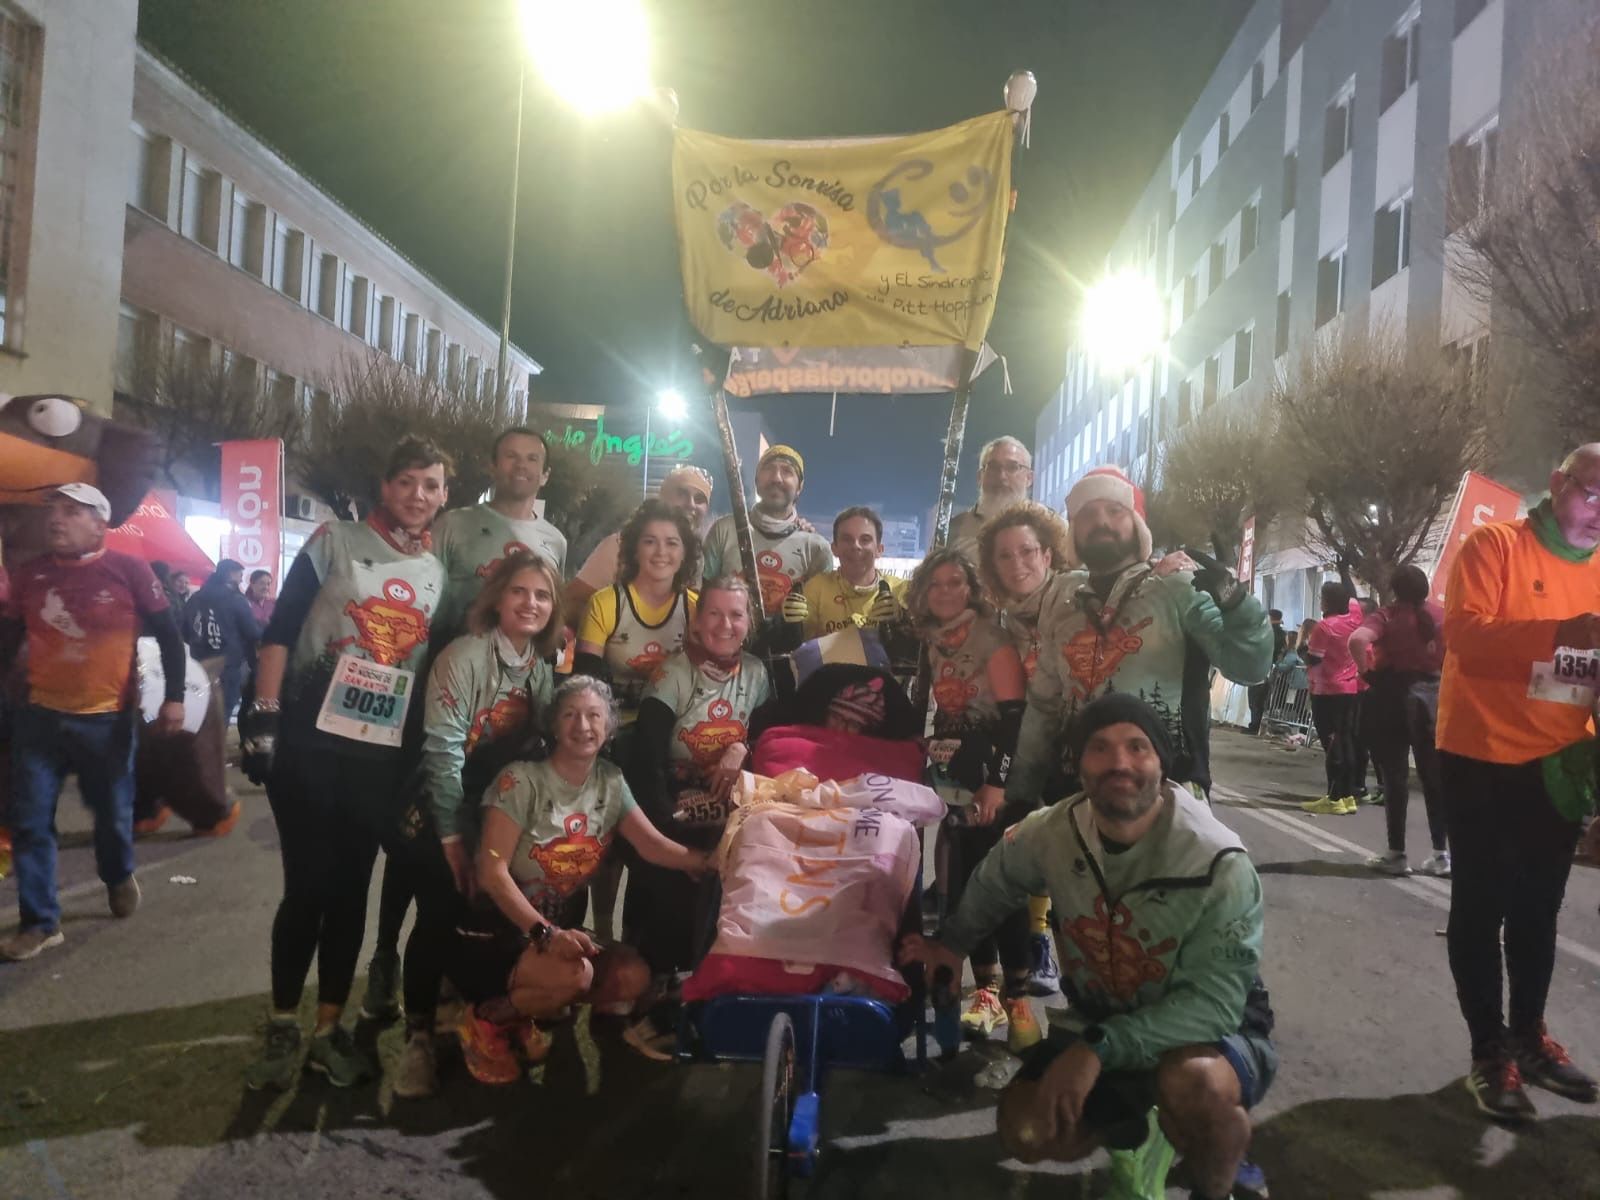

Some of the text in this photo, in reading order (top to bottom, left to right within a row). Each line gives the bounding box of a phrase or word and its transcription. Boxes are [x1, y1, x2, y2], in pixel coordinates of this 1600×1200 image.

[686, 160, 855, 212] Por la Sonrisa
[709, 288, 850, 323] de Adriana
[342, 686, 397, 718] 9033
